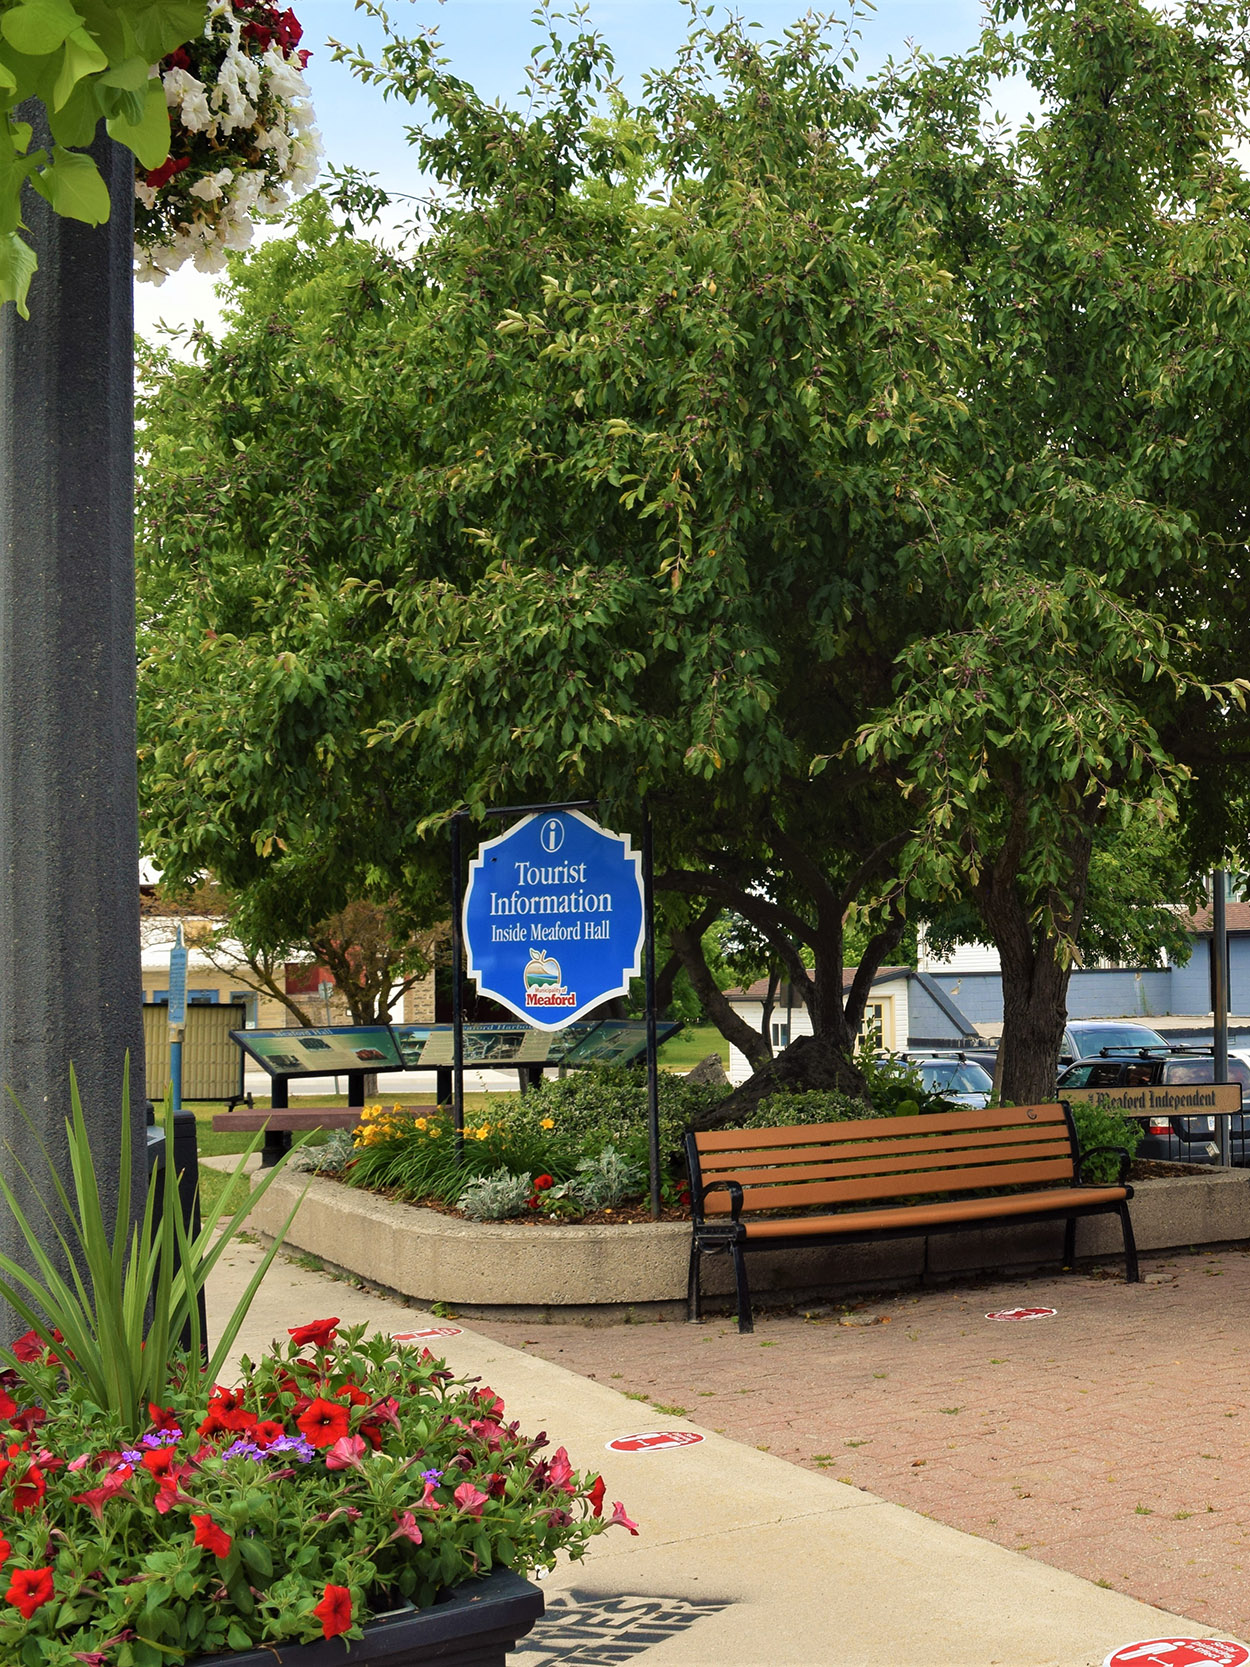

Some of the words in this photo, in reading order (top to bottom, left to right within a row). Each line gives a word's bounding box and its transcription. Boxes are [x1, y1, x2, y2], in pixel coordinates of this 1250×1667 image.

[514, 860, 587, 886] Tourist
[490, 889, 613, 915] Information
[491, 923, 527, 942] Inside
[530, 921, 580, 941] Meaford
[584, 919, 610, 940] Hall
[526, 993, 576, 1006] Meaford
[1096, 1092, 1146, 1109] Meaford
[1149, 1089, 1216, 1111] Independent
